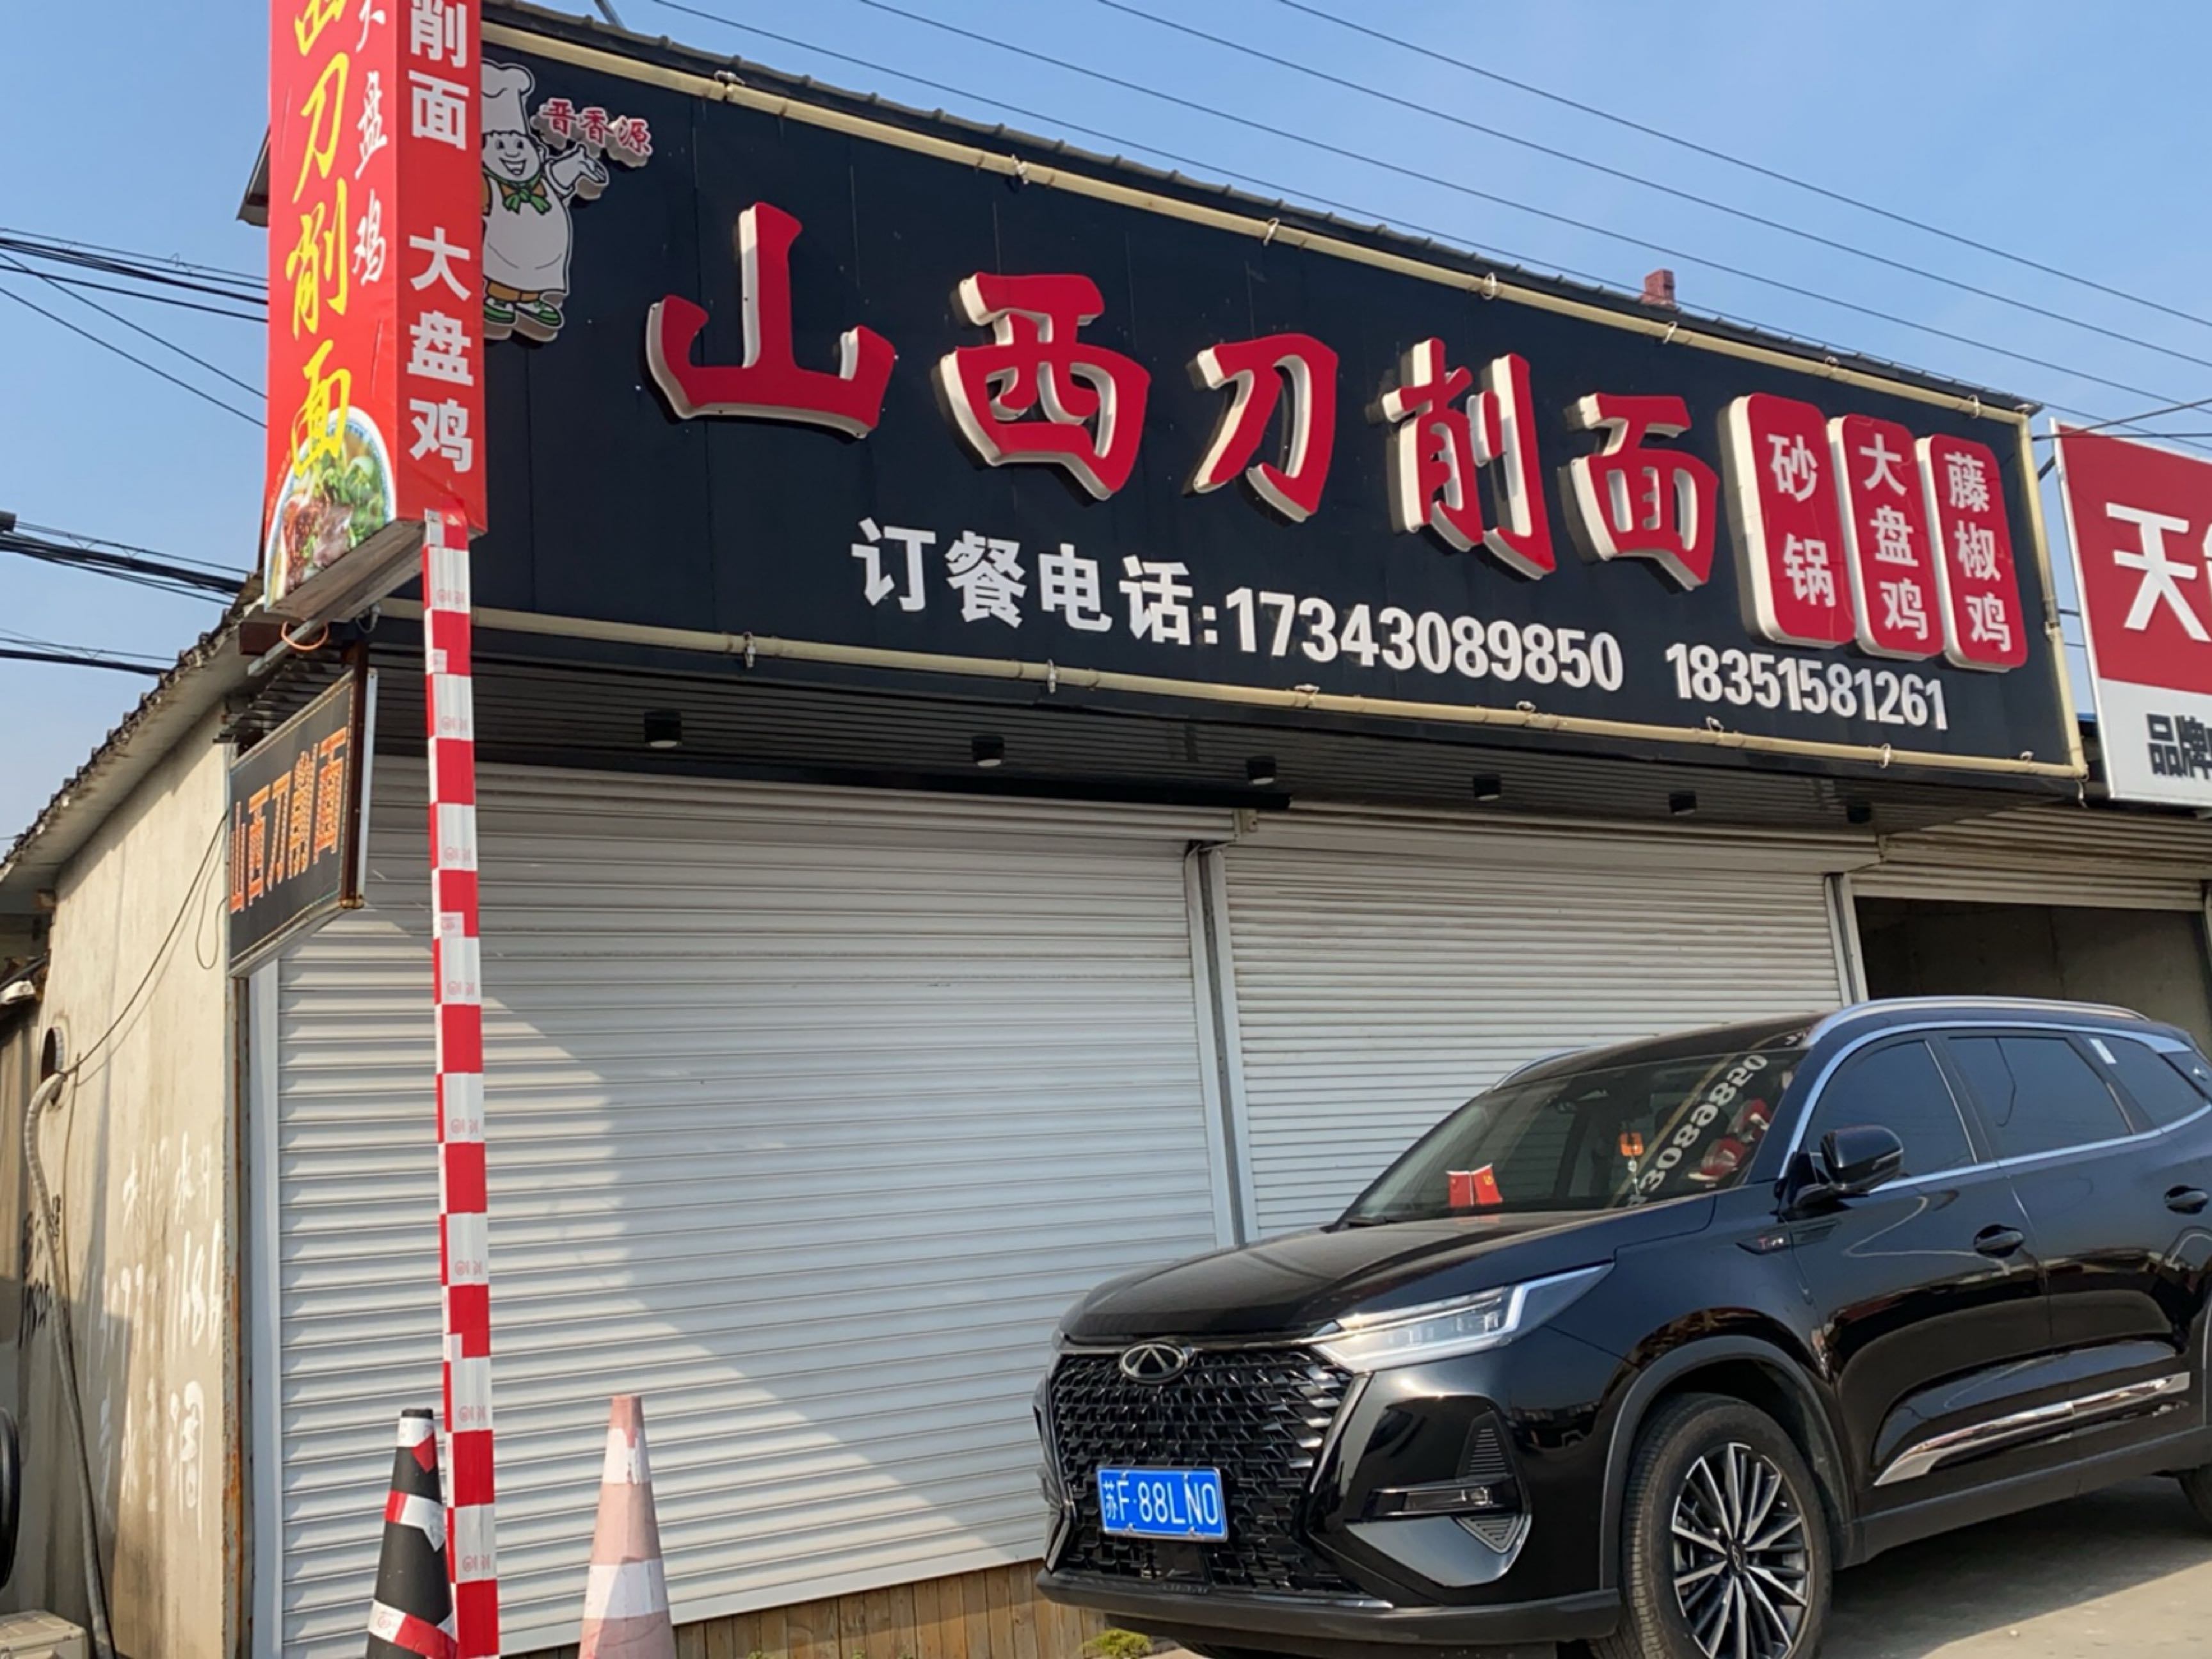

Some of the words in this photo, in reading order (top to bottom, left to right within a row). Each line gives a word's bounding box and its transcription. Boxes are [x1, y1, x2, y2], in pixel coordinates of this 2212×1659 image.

[407, 0, 470, 151] 削面
[540, 97, 653, 157] 晋香源
[406, 226, 474, 474] 大盘鸡
[646, 201, 1719, 590] 山西刀削面
[1767, 432, 1838, 609] 砂锅
[1859, 433, 1928, 641] 大盘鸡
[1944, 451, 2012, 653] 藤椒鸡
[2104, 502, 2212, 643] 天
[1665, 642, 1948, 730] 18351581261
[2145, 712, 2212, 780] 品牌
